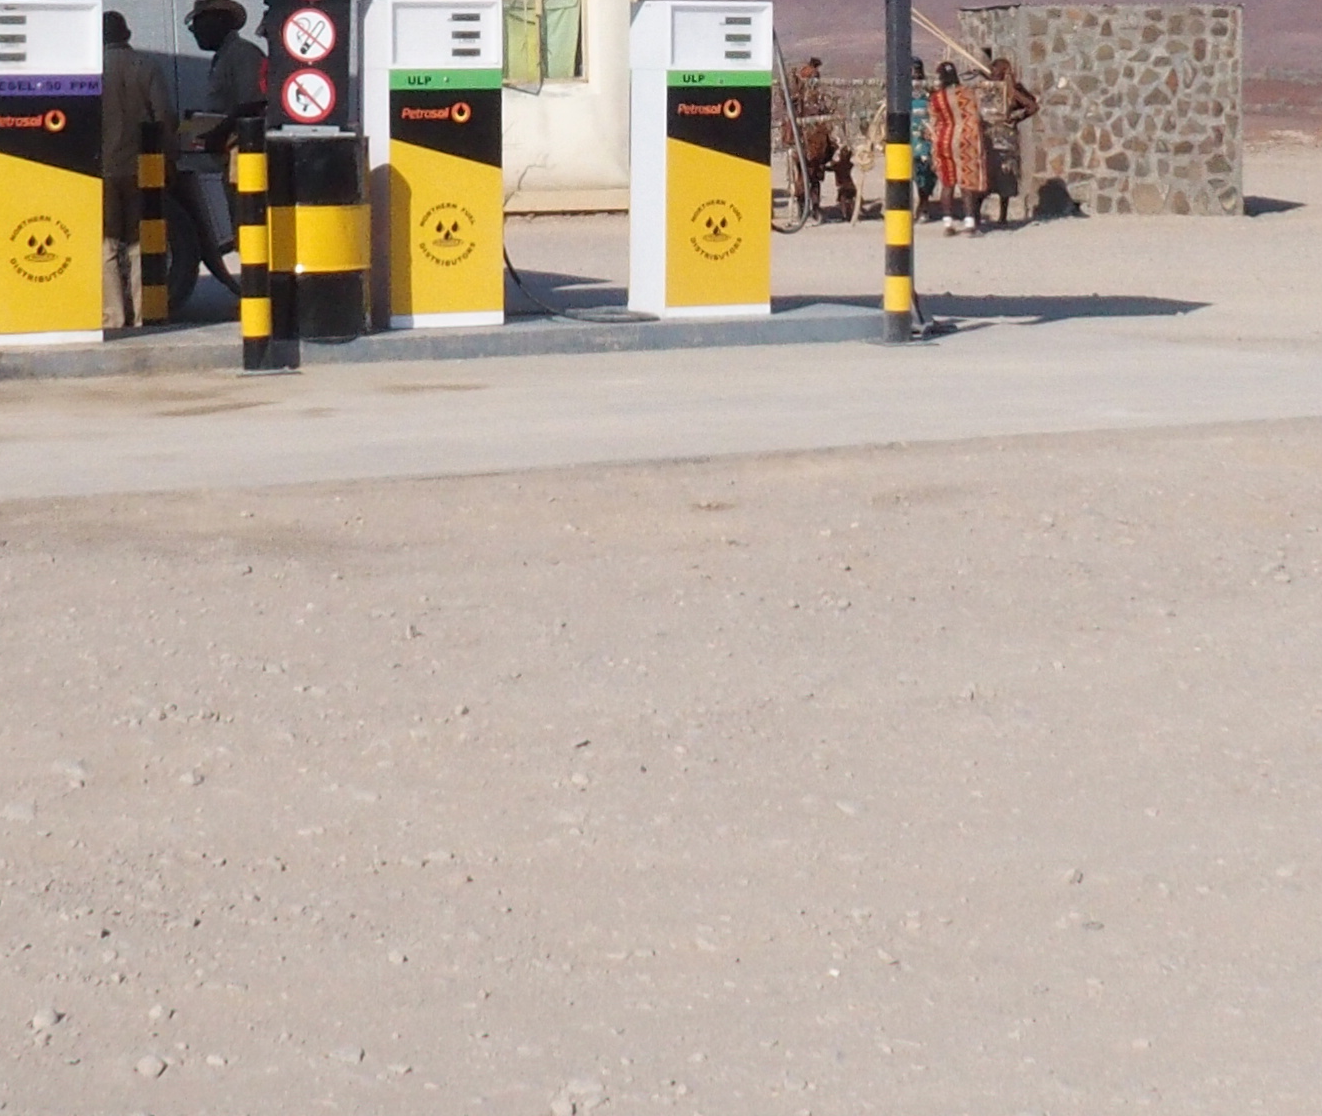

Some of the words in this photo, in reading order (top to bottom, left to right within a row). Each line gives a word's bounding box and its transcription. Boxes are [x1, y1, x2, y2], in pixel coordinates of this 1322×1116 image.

[407, 75, 432, 85] ULP
[682, 74, 706, 83] ULP
[401, 107, 450, 120] Petrosol
[678, 103, 723, 116] Petrosol
[419, 202, 458, 228] NORTHERN
[460, 207, 476, 226] FUEL
[9, 215, 52, 242] NORTHERN
[54, 219, 72, 240] FUEL
[419, 242, 476, 267] DISTRIBUTORS
[9, 256, 73, 283] DISTRIBUTORS
